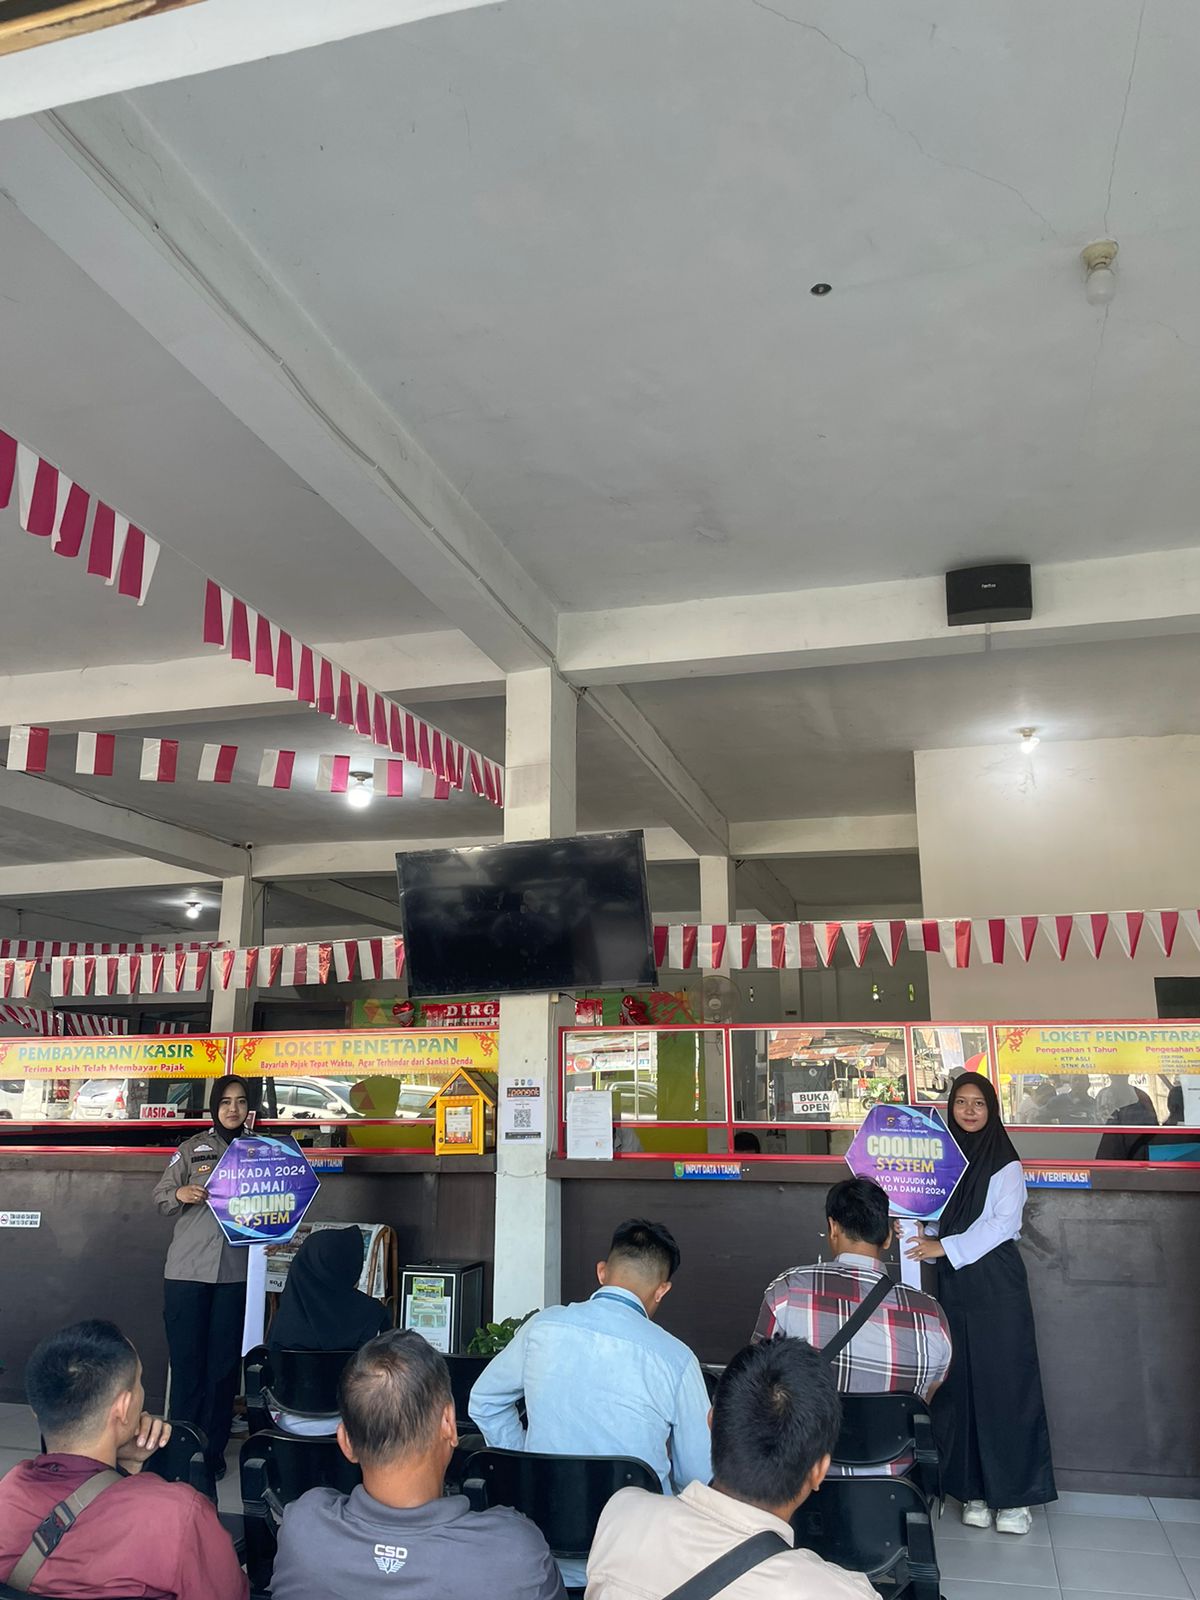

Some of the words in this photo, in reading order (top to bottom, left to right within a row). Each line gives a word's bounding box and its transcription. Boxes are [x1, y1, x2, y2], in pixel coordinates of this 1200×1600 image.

[1040, 1031, 1091, 1042] LOKET
[19, 1044, 194, 1061] PEMBAYARAN/KASIR
[275, 1041, 336, 1057] LOKET
[342, 1038, 458, 1055] PENETAPAN
[1036, 1046, 1084, 1054] Pengesahan
[1146, 1046, 1194, 1054] Pengesahan
[24, 1065, 53, 1073] Terima
[55, 1065, 80, 1073] Kasih
[83, 1064, 107, 1072] Telah
[109, 1063, 158, 1074] Membayar
[160, 1063, 185, 1073] Pajak
[261, 1060, 289, 1070] Bayarlah
[290, 1060, 308, 1070] Pajak
[311, 1060, 328, 1069] Tepat
[358, 1059, 375, 1068] Agar
[377, 1058, 410, 1067] Terhindar
[411, 1058, 425, 1066] dari
[426, 1057, 449, 1066] Sanksi
[451, 1057, 473, 1065] Denda
[799, 1093, 830, 1102] BUKA
[142, 1107, 167, 1118] KASIR
[801, 1103, 830, 1112] OPEN
[867, 1135, 944, 1160] COOLING
[685, 1164, 701, 1174] INPUT
[702, 1164, 717, 1174] DATA
[721, 1164, 740, 1174] TAHUN
[876, 1157, 935, 1173] SYSTEM
[219, 1167, 272, 1180] PILKADA
[275, 1165, 306, 1176] 2024
[1042, 1172, 1088, 1183] VERIFIKASI
[875, 1175, 892, 1183] AYO
[893, 1176, 937, 1186] WUJUDKAN
[241, 1180, 285, 1194] DAMAI
[880, 1184, 898, 1192] ADA
[900, 1185, 924, 1194] DAMAI
[925, 1187, 946, 1195] 2024
[228, 1193, 296, 1216] COOLING
[235, 1212, 290, 1227] SYSTEM
[374, 1544, 408, 1559] CSD
